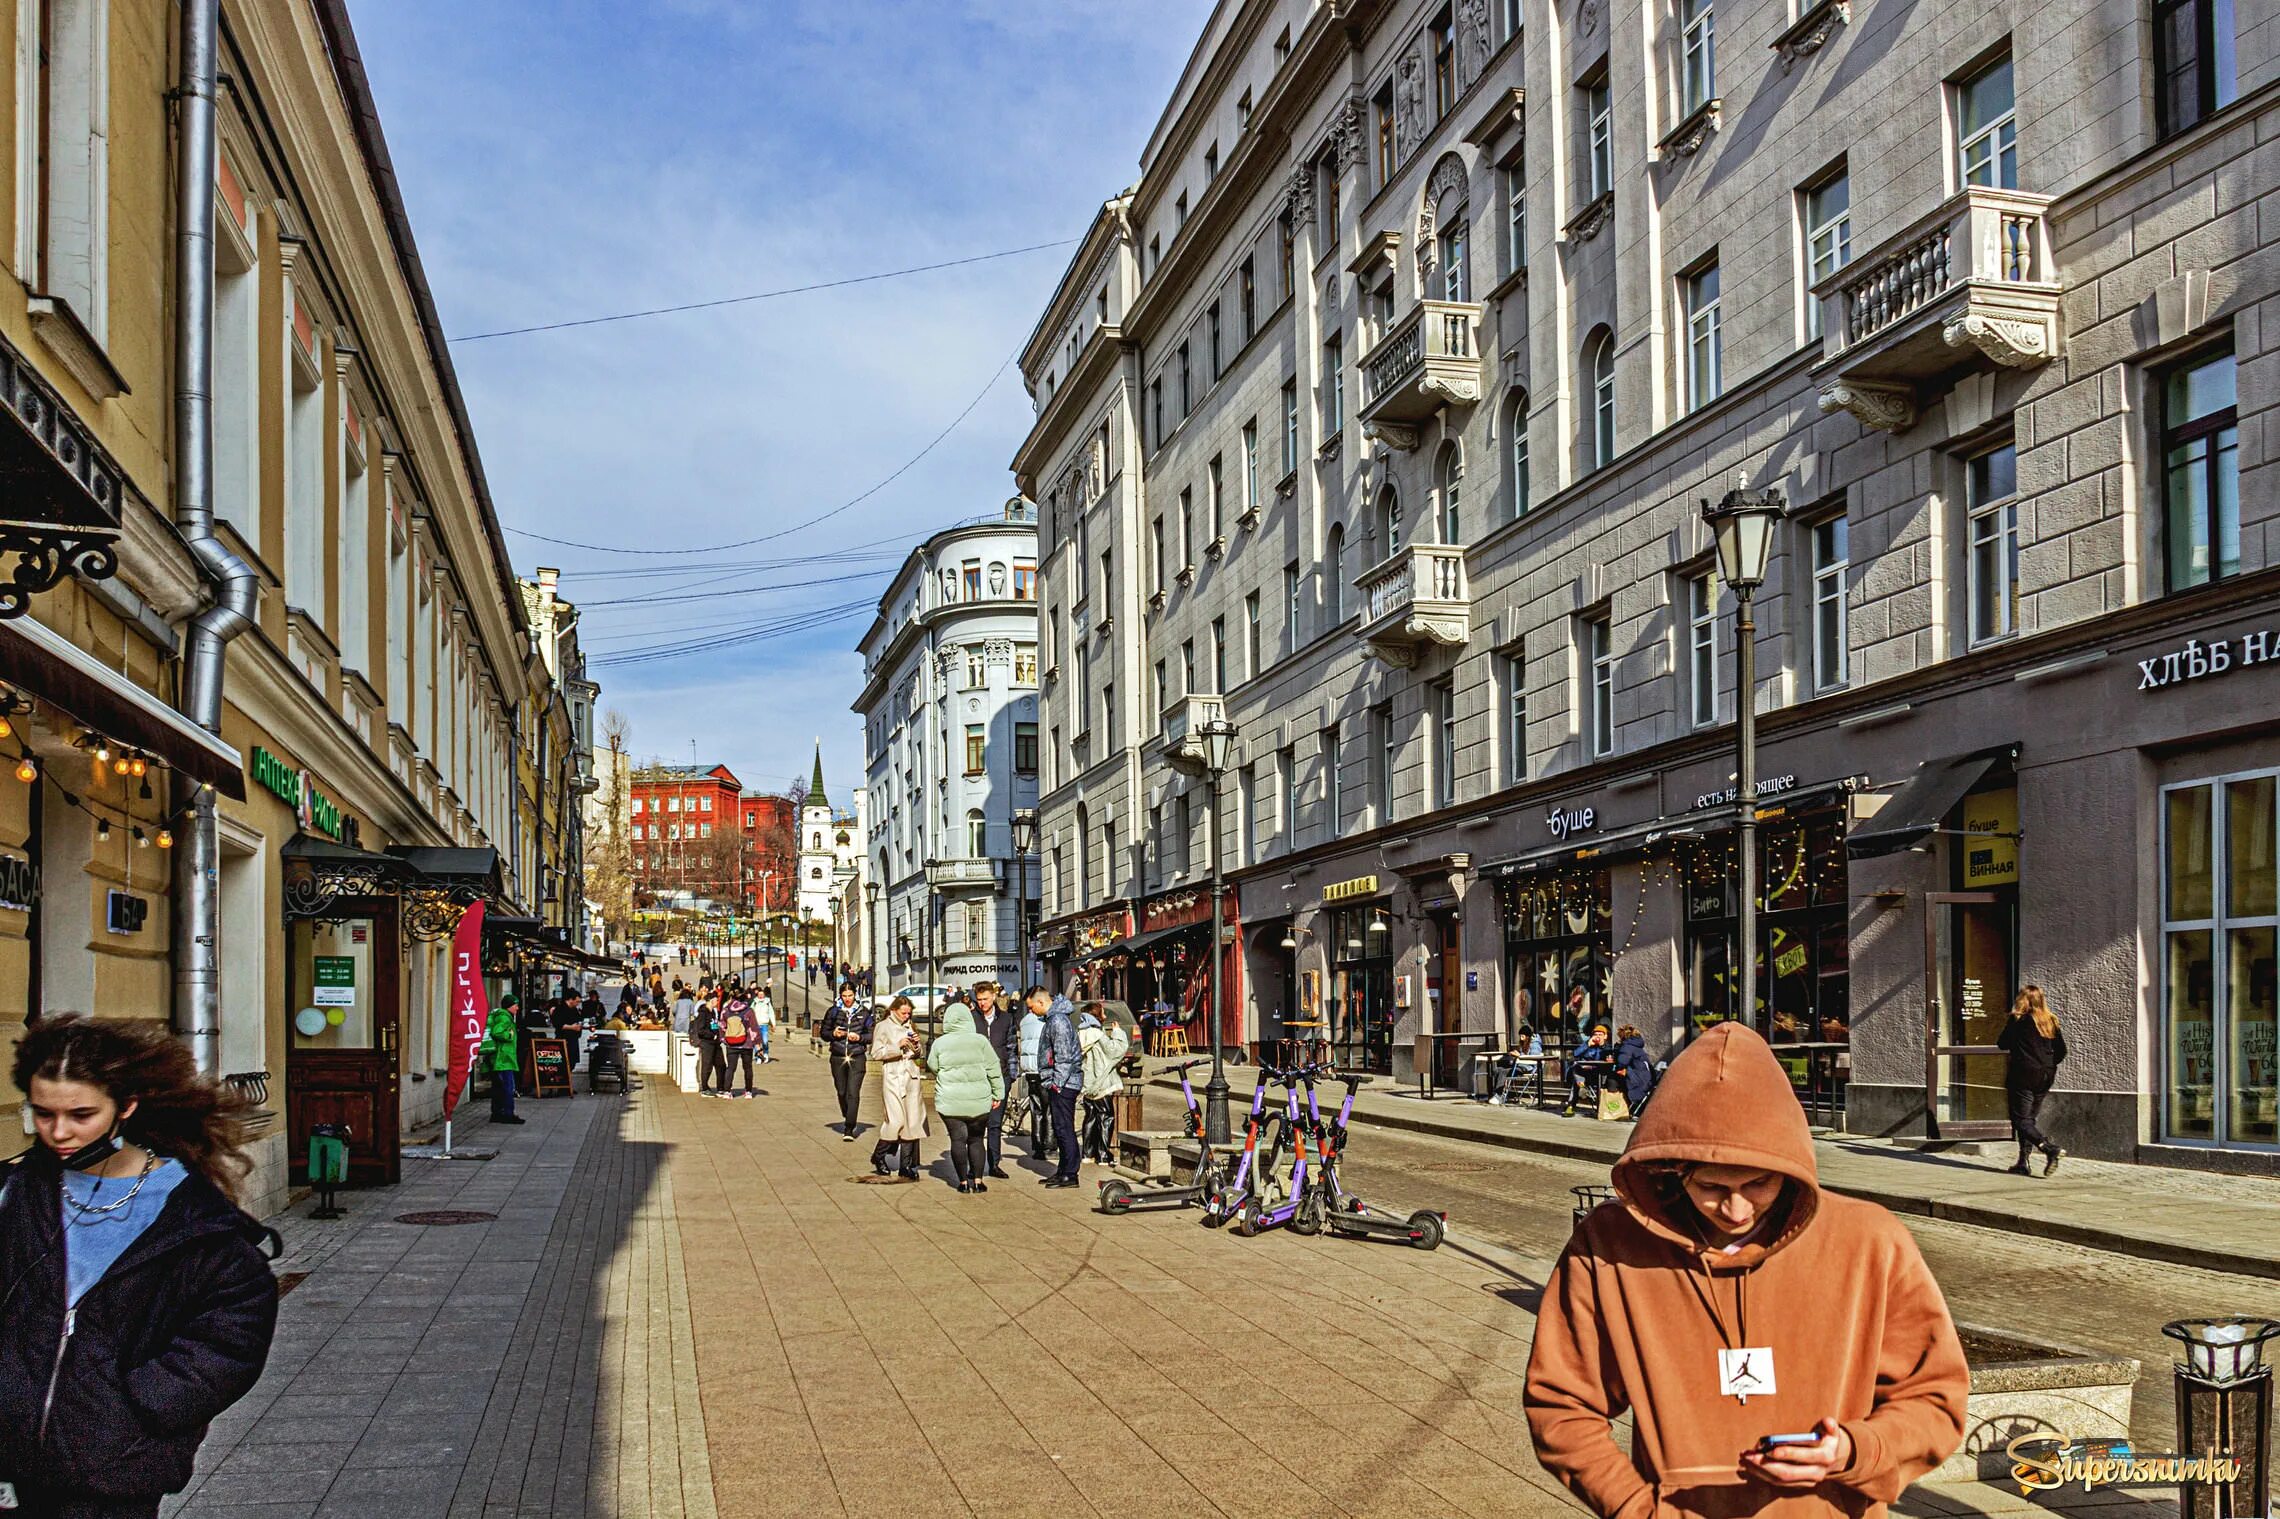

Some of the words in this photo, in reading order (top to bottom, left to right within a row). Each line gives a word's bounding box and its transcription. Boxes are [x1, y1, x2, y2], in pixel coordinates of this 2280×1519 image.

[2138, 640, 2230, 690] ХЛѢБ
[1697, 791, 1723, 808] есть
[1551, 807, 1594, 840] буше
[1969, 861, 2014, 878] ВИННАЯ
[969, 964, 1019, 974] СОЛЯНКА
